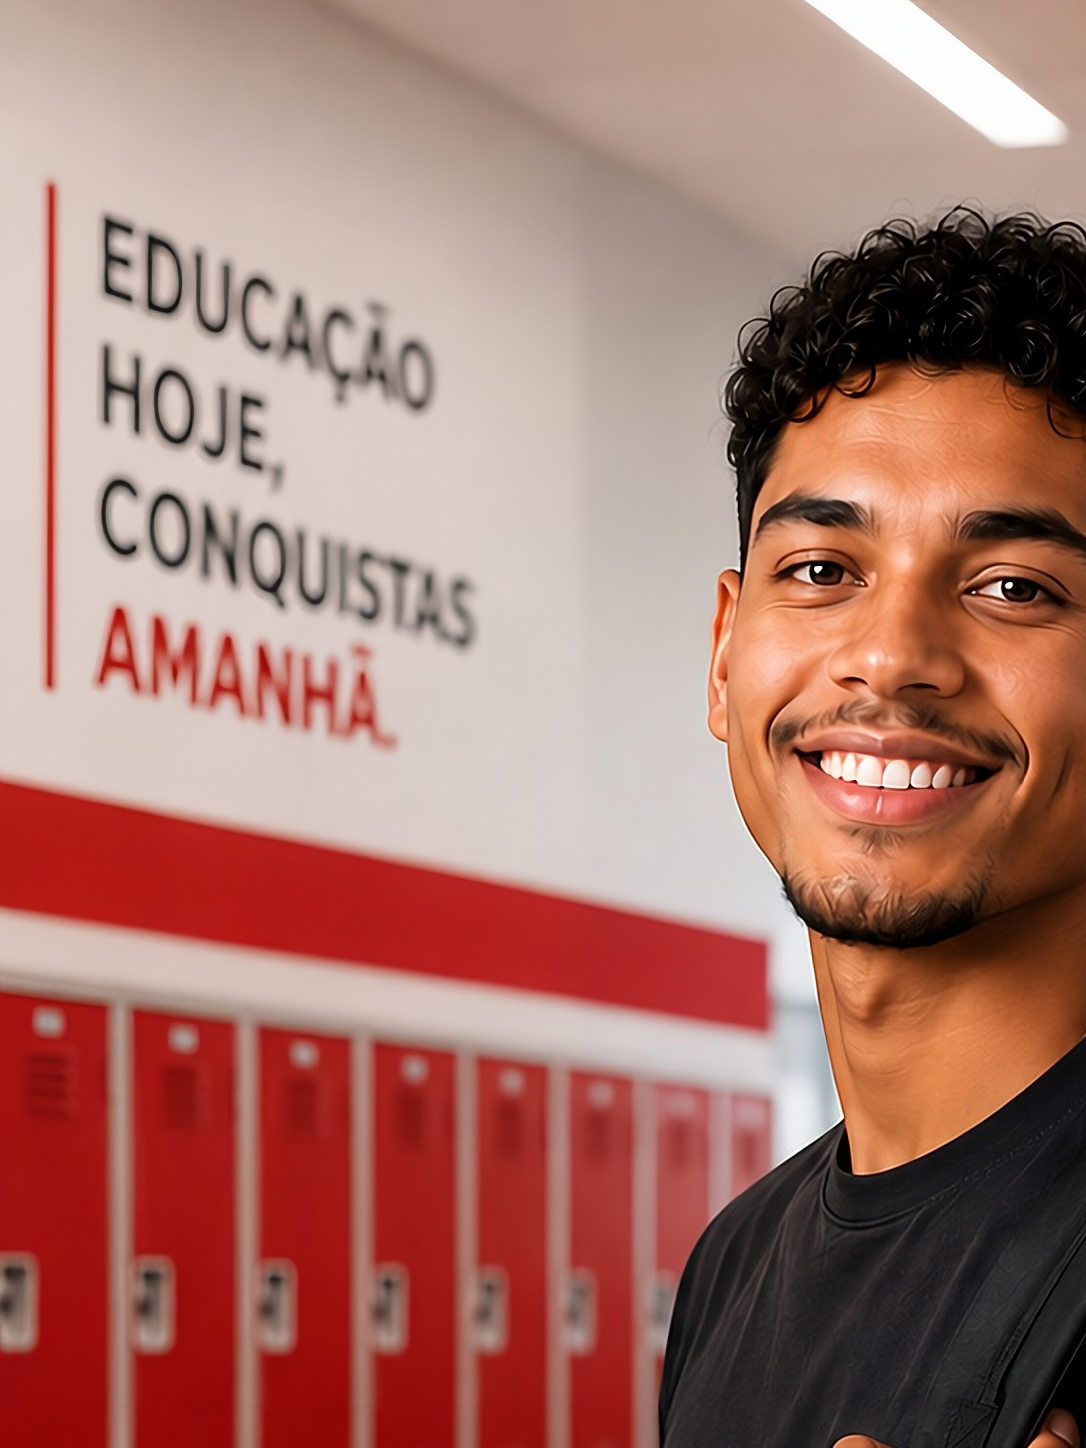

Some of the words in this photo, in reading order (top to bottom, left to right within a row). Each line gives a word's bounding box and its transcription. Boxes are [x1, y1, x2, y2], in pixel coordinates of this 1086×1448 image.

[101, 213, 436, 414] EDUCAÇÃO
[101, 343, 284, 490] HOJE,
[99, 476, 475, 650] CONQUISTAS
[96, 605, 397, 749] AMANHÃ.
